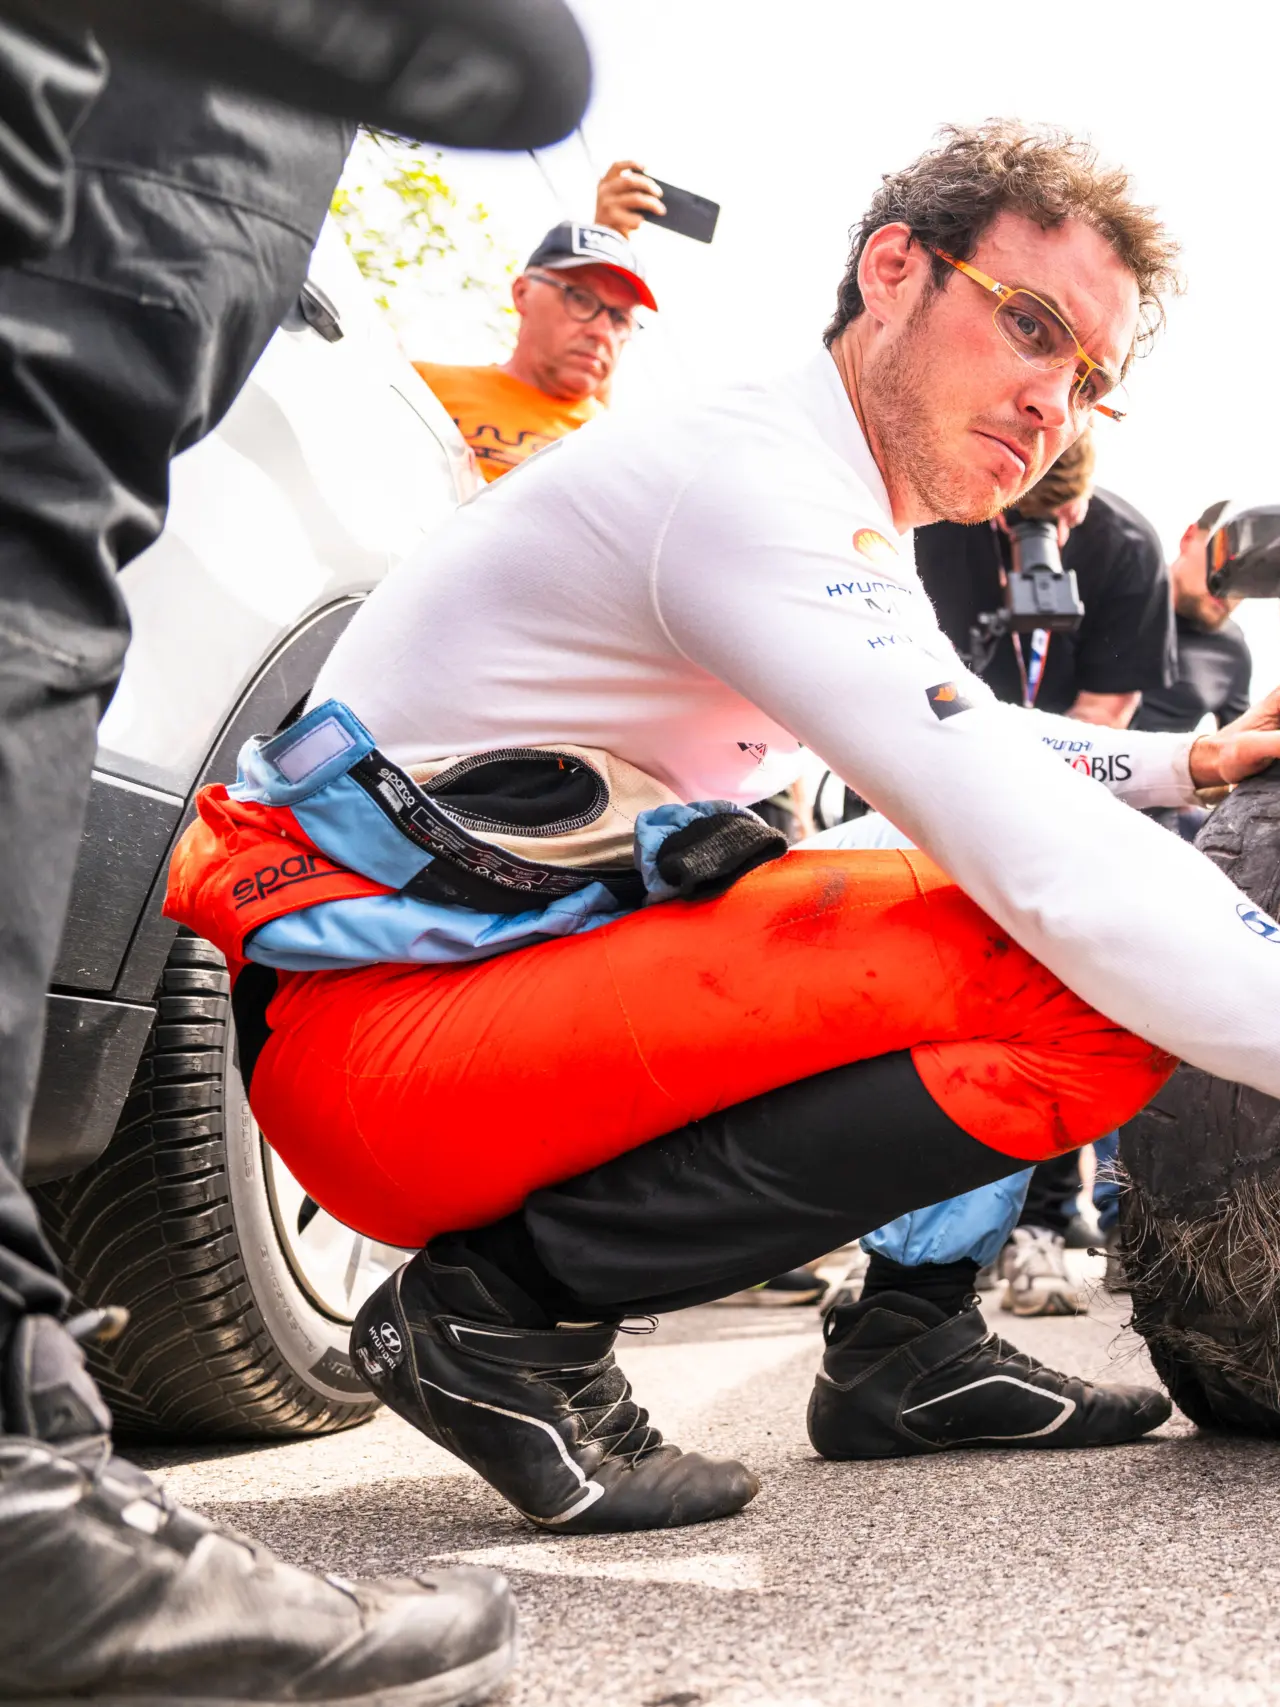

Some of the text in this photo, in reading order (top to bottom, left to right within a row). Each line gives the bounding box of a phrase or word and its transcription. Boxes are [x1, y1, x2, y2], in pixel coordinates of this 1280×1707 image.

[826, 582, 911, 597] HYUN
[379, 768, 415, 807] sparco
[1064, 754, 1132, 782] OBIS
[232, 854, 317, 901] spar
[369, 1325, 397, 1370] HYUNDAI
